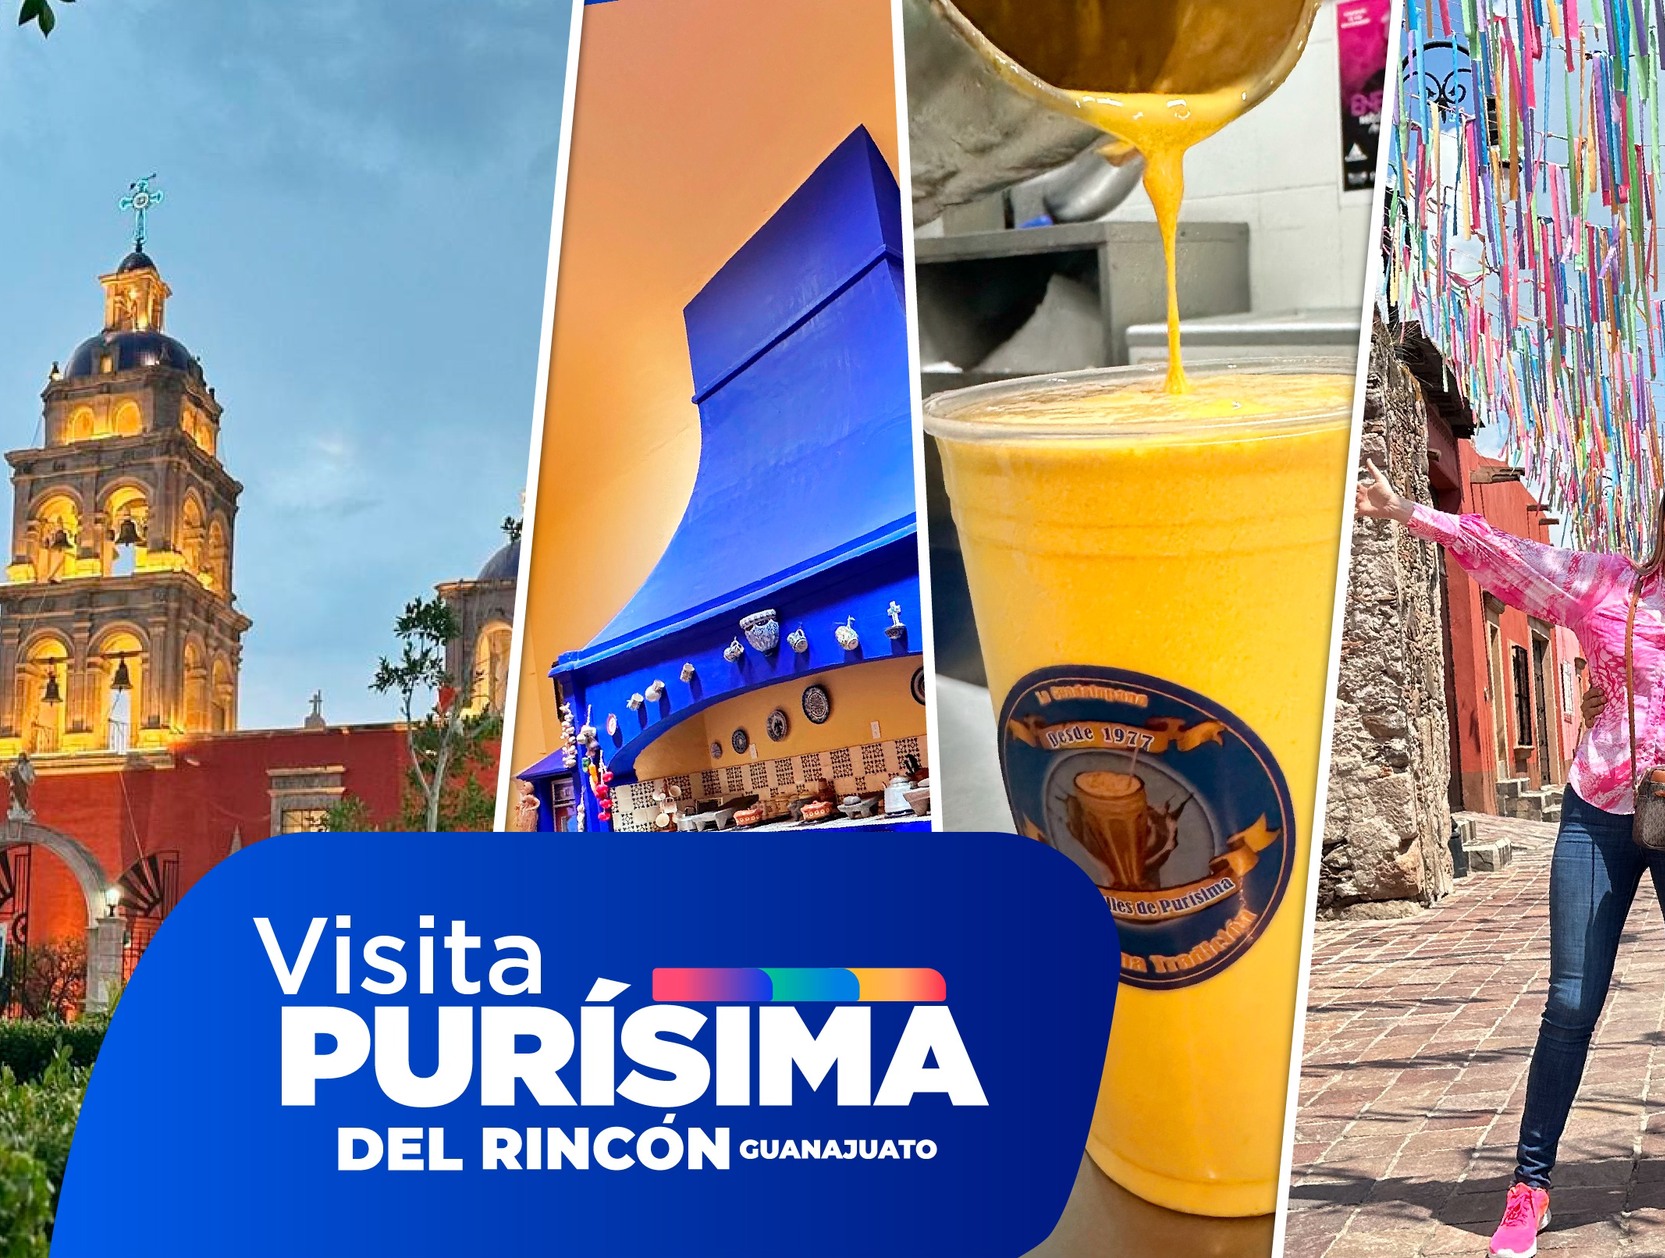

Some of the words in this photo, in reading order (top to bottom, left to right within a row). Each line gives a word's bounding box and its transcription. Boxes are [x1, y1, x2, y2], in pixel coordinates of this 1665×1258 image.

[1047, 725, 1094, 749] Desde
[1102, 726, 1155, 752] 1977
[1136, 901, 1157, 915] de
